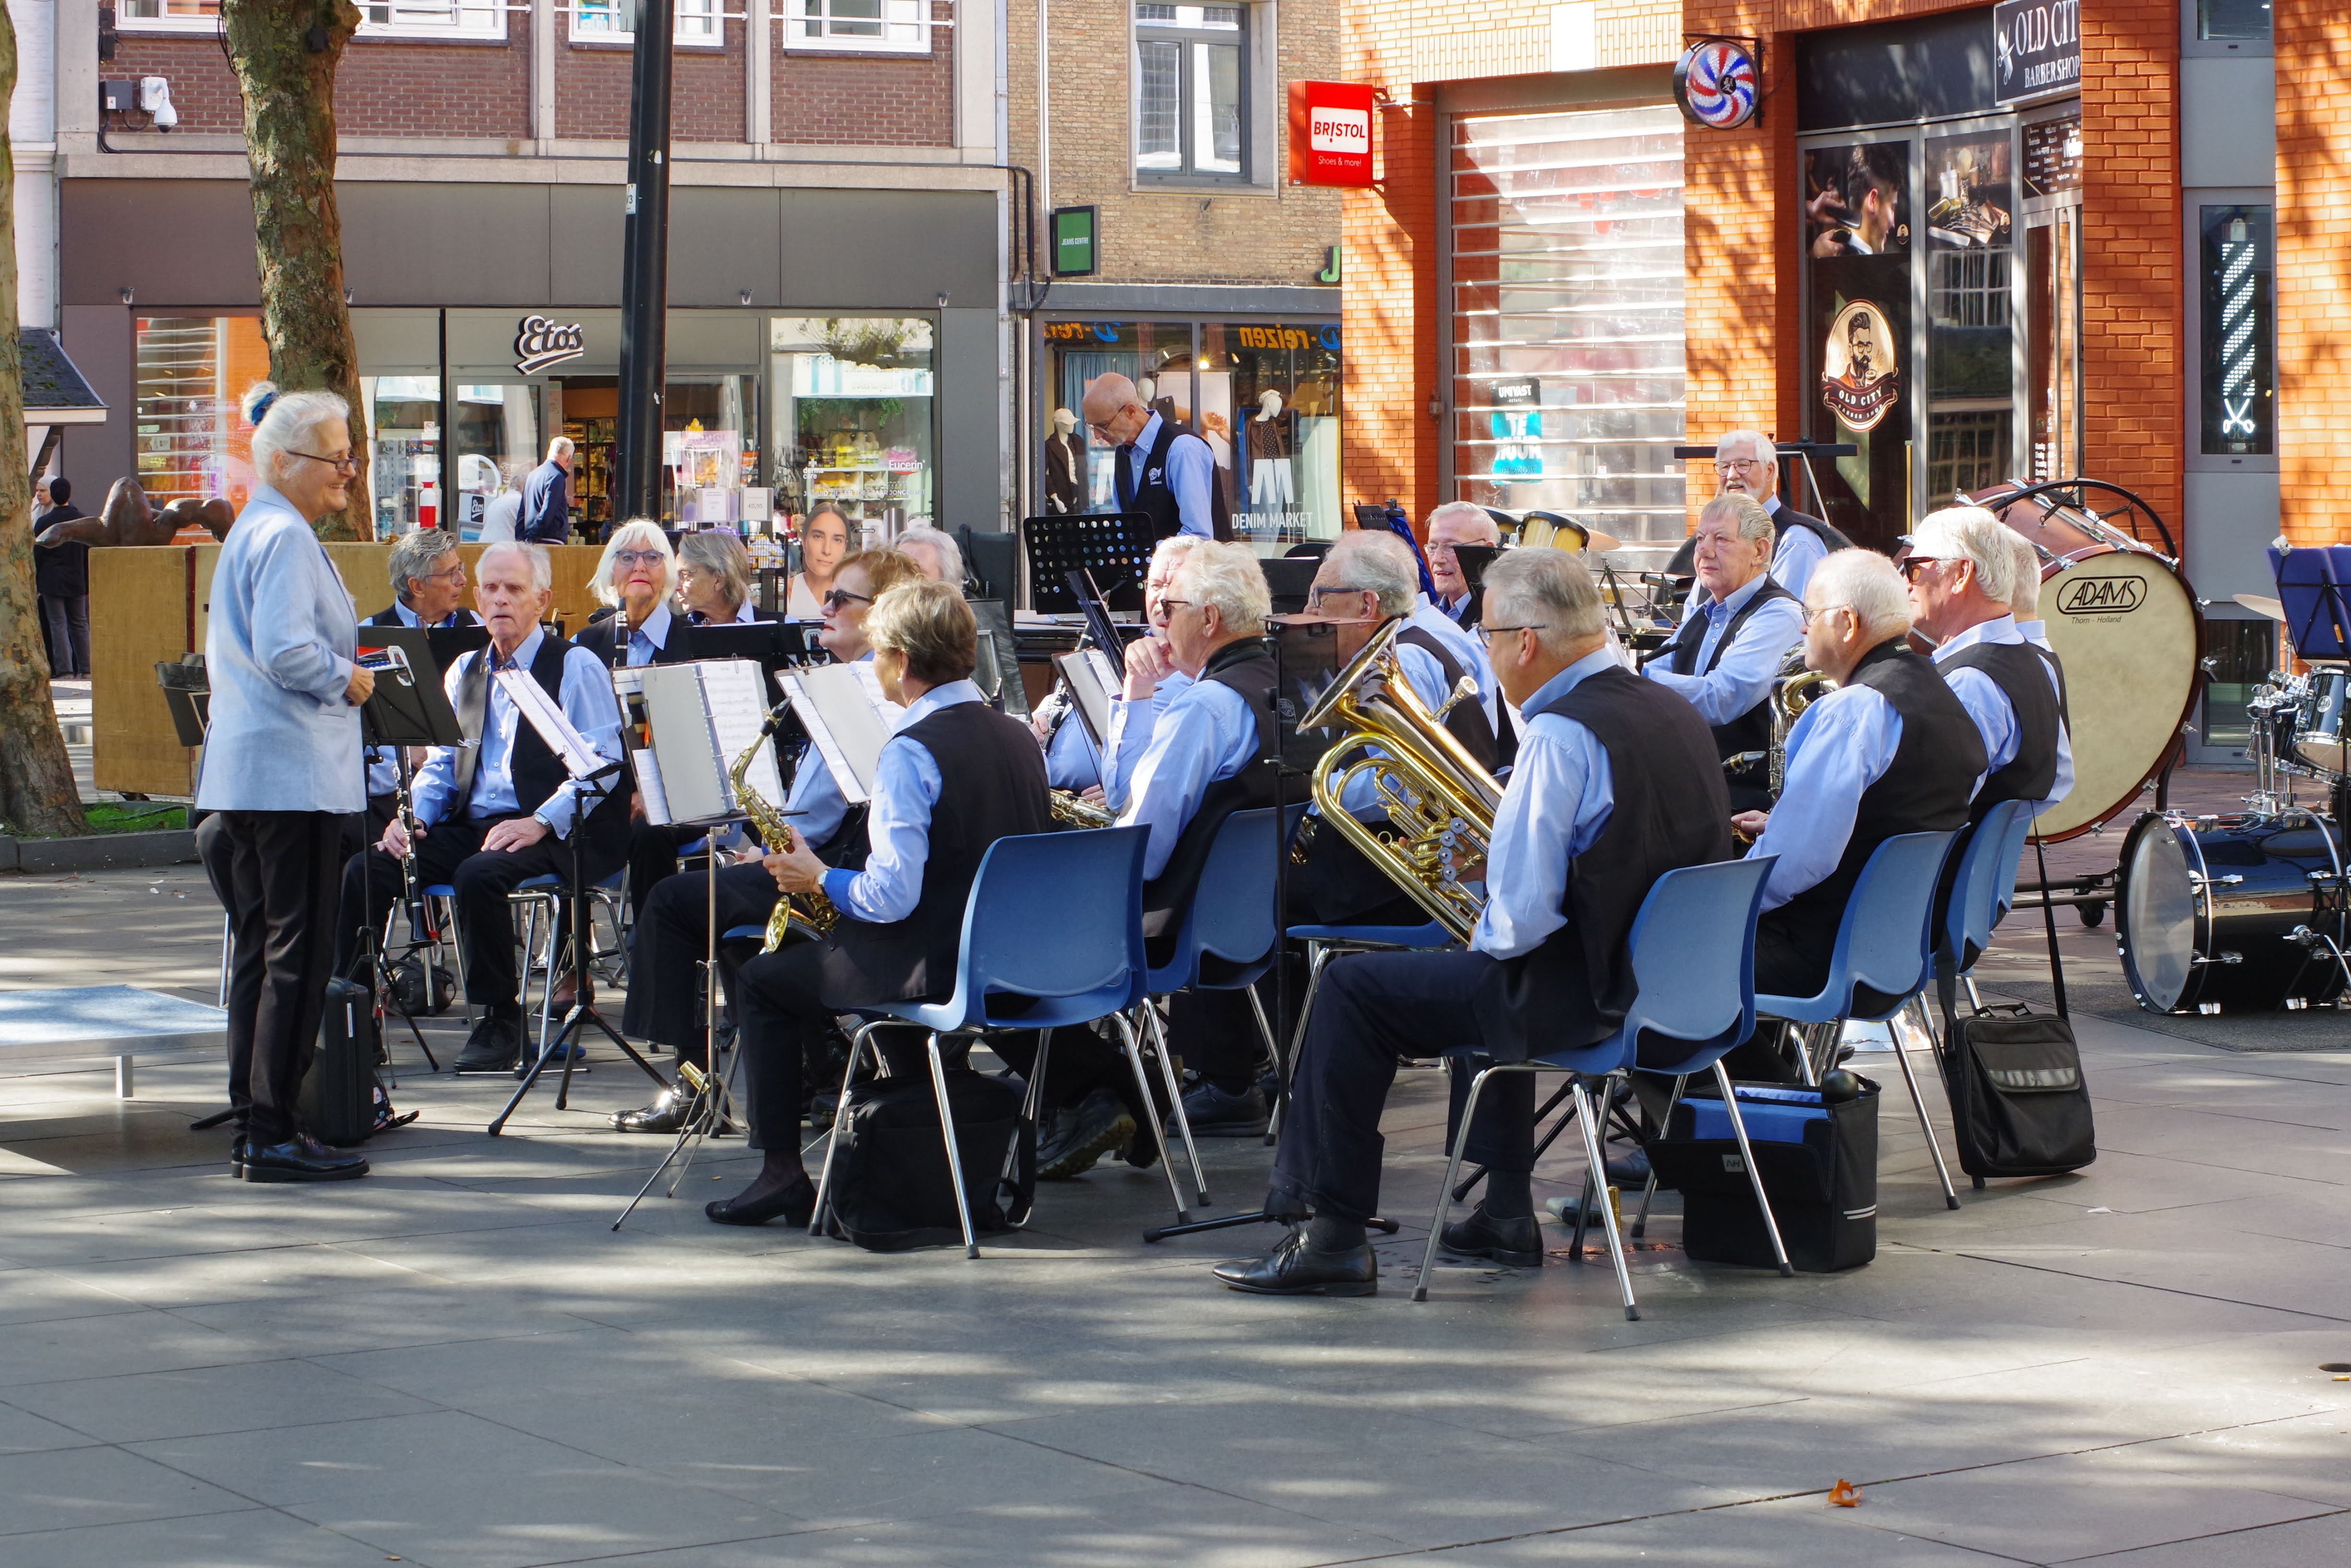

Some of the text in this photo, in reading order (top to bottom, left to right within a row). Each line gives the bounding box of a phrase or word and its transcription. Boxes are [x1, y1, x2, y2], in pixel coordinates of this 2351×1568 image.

[2015, 0, 2079, 56] OLD CIT
[2024, 55, 2080, 88] BARBER SHOP
[1318, 156, 1362, 167] Shoes & more!
[1074, 237, 1089, 245] CENTRE
[519, 315, 584, 358] Etos
[1498, 385, 1532, 398] UNIVAST
[1839, 386, 1882, 406] OLD CITY
[1838, 404, 1882, 419] BARBER SHOP
[1505, 413, 1528, 436] TE
[889, 459, 923, 470] Eucerin
[472, 499, 483, 513] Etos
[1232, 512, 1313, 529] DENIM MARKET
[2065, 580, 2136, 610] ADAMS
